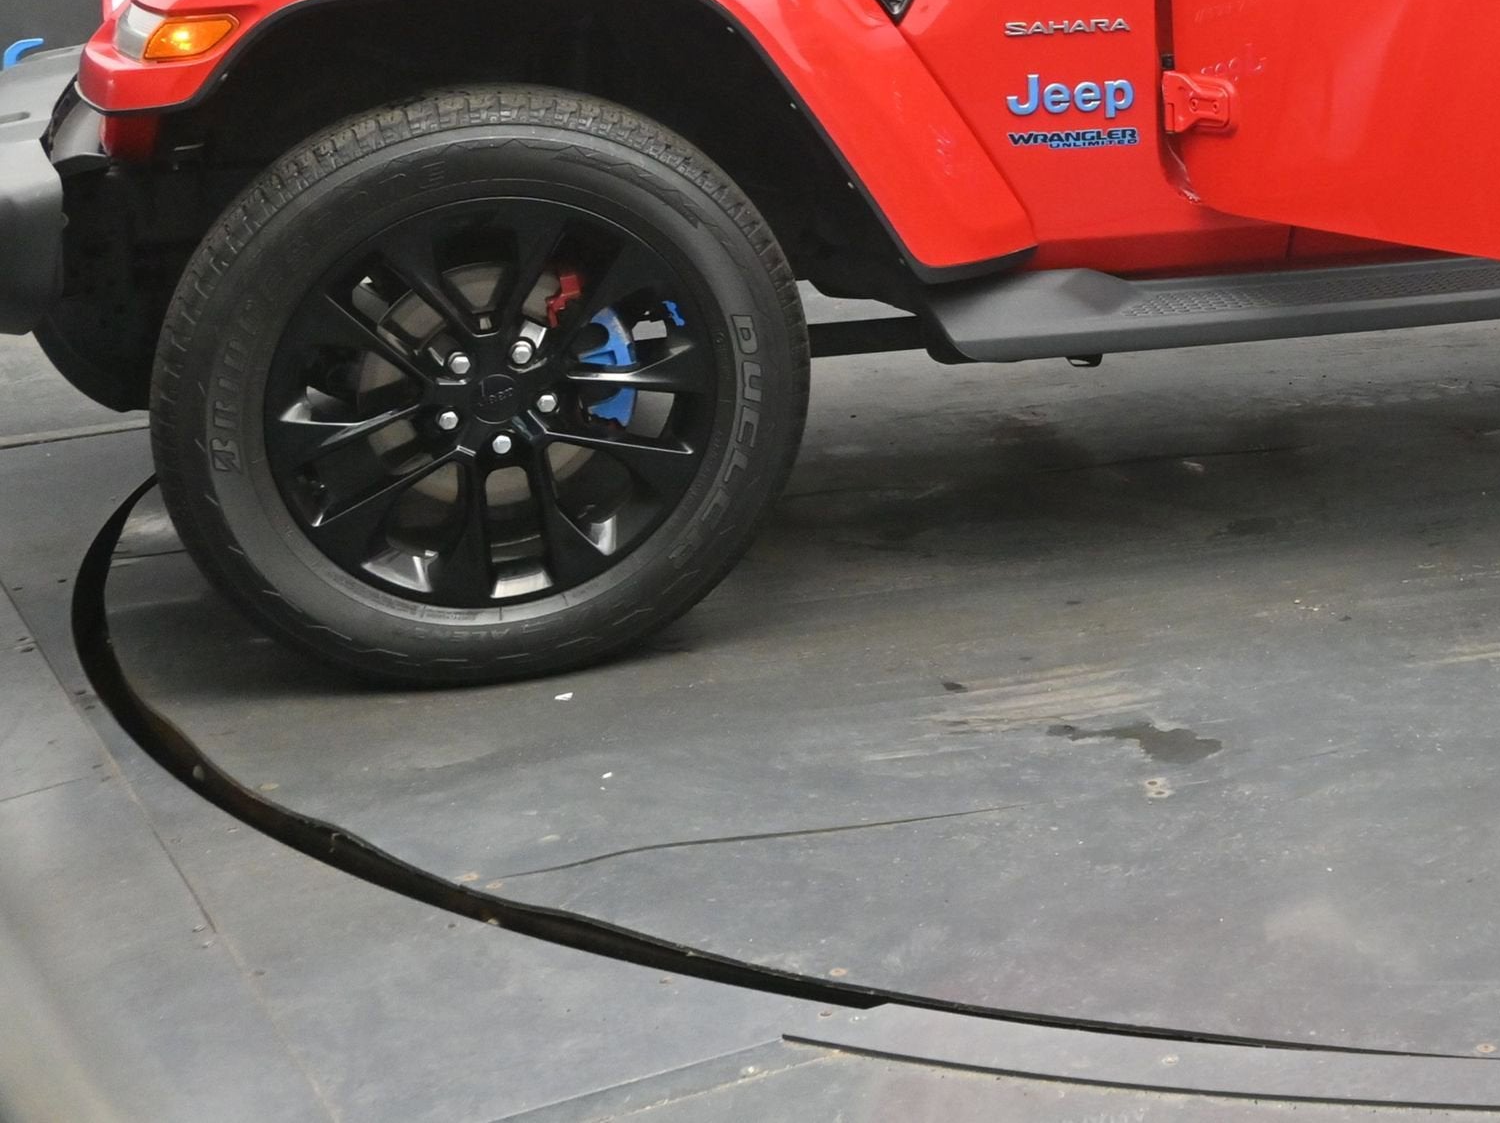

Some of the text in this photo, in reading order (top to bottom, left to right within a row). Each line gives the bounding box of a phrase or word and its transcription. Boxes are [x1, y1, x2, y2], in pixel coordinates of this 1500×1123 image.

[1004, 18, 1131, 37] SAHARA
[1006, 74, 1134, 119] Jeep
[1008, 127, 1138, 146] WRANGLER
[1049, 139, 1138, 149] UNLIMITED
